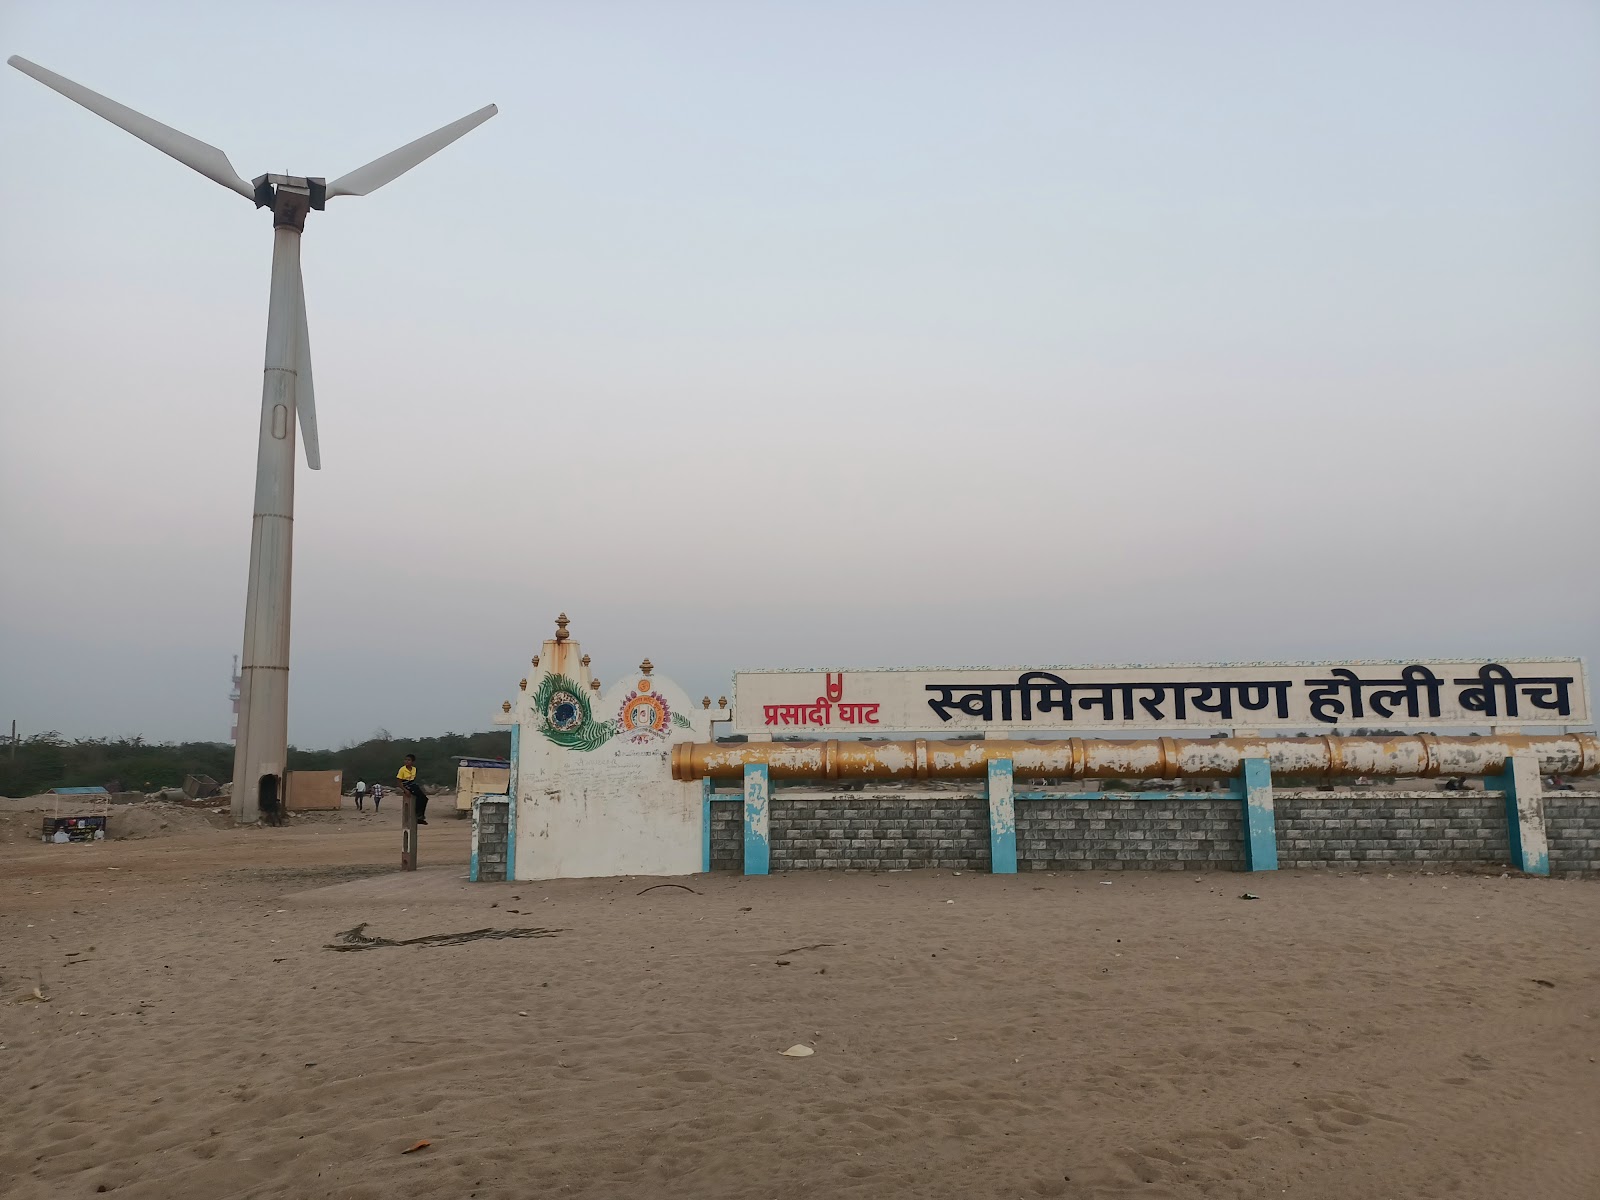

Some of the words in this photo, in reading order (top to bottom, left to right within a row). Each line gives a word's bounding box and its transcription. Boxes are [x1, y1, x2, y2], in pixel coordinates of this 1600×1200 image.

[763, 696, 832, 727] प्रसादी
[838, 702, 881, 725] घाट
[925, 671, 1293, 723] स्वामिनारायण
[1304, 664, 1445, 725] होली
[1453, 663, 1574, 718] बीच
